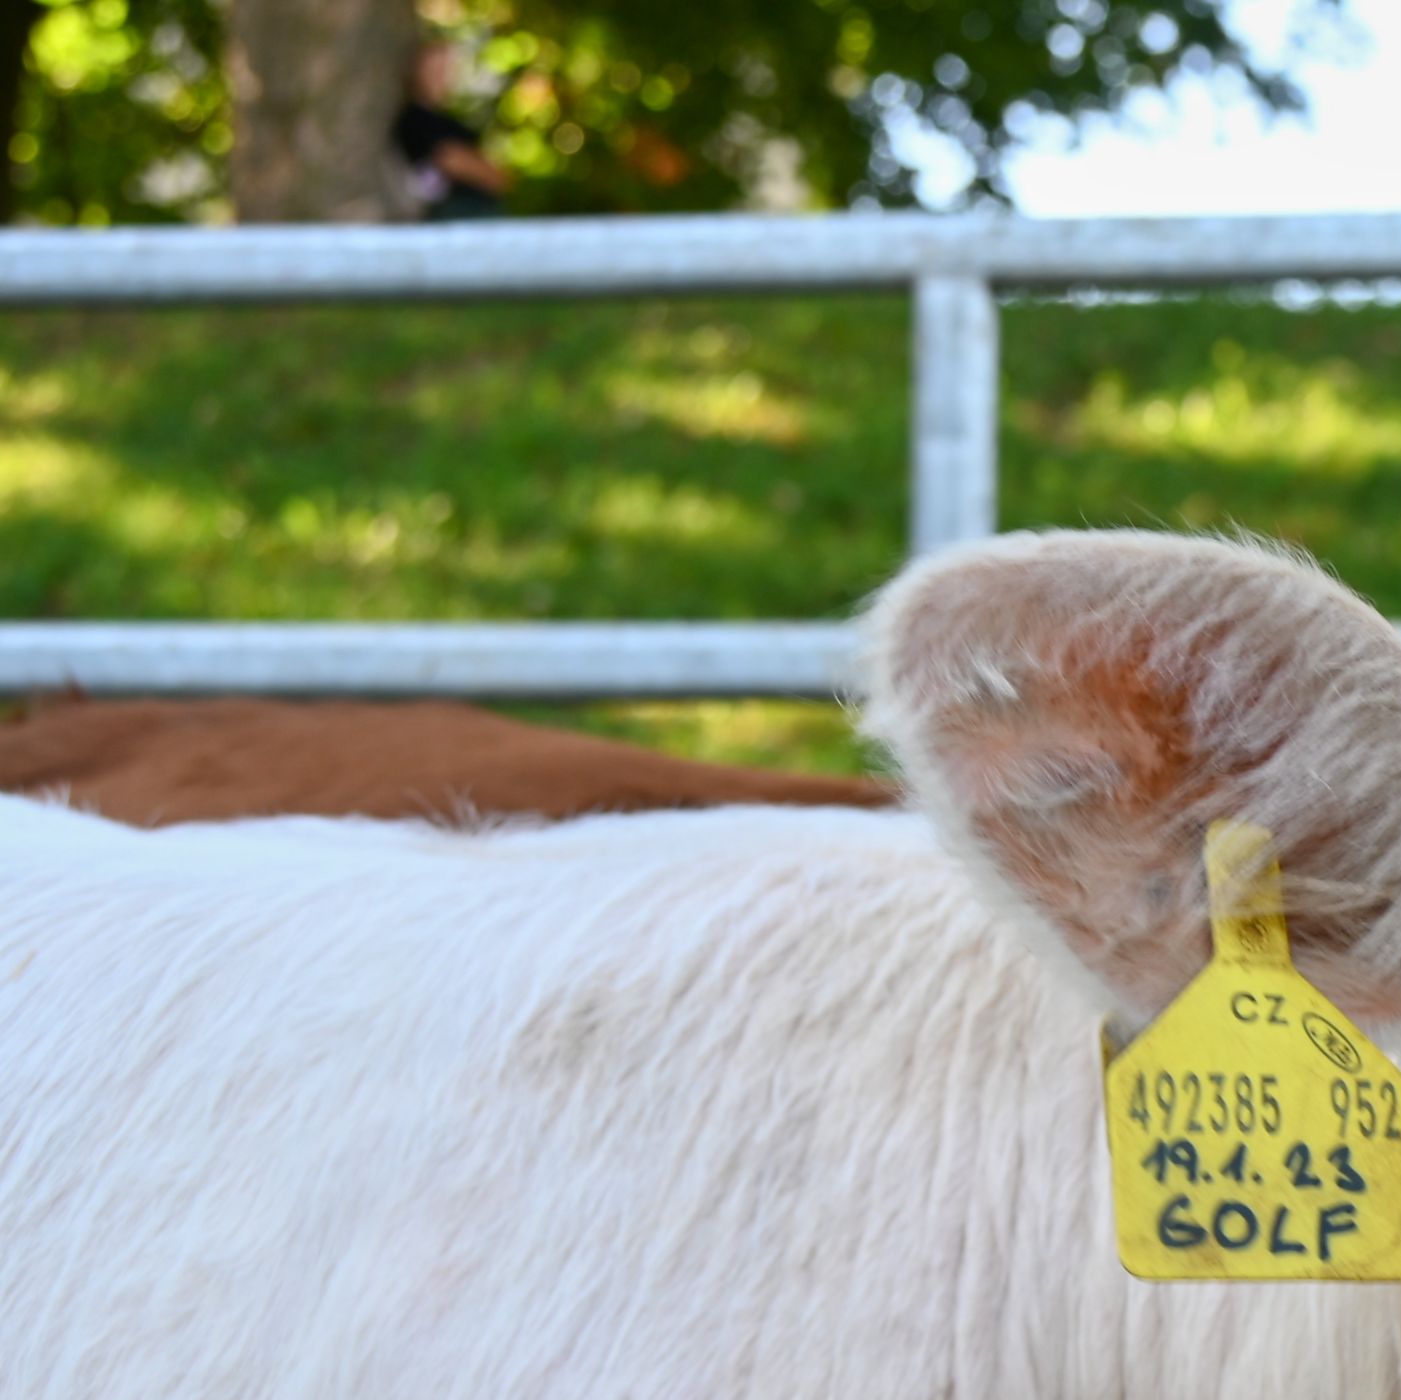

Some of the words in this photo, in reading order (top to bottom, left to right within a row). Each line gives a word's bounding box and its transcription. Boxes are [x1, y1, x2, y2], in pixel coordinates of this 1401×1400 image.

[1231, 992, 1289, 1025] CZ
[1128, 1070, 1281, 1135] 492385
[1157, 1194, 1359, 1261] GOLF
